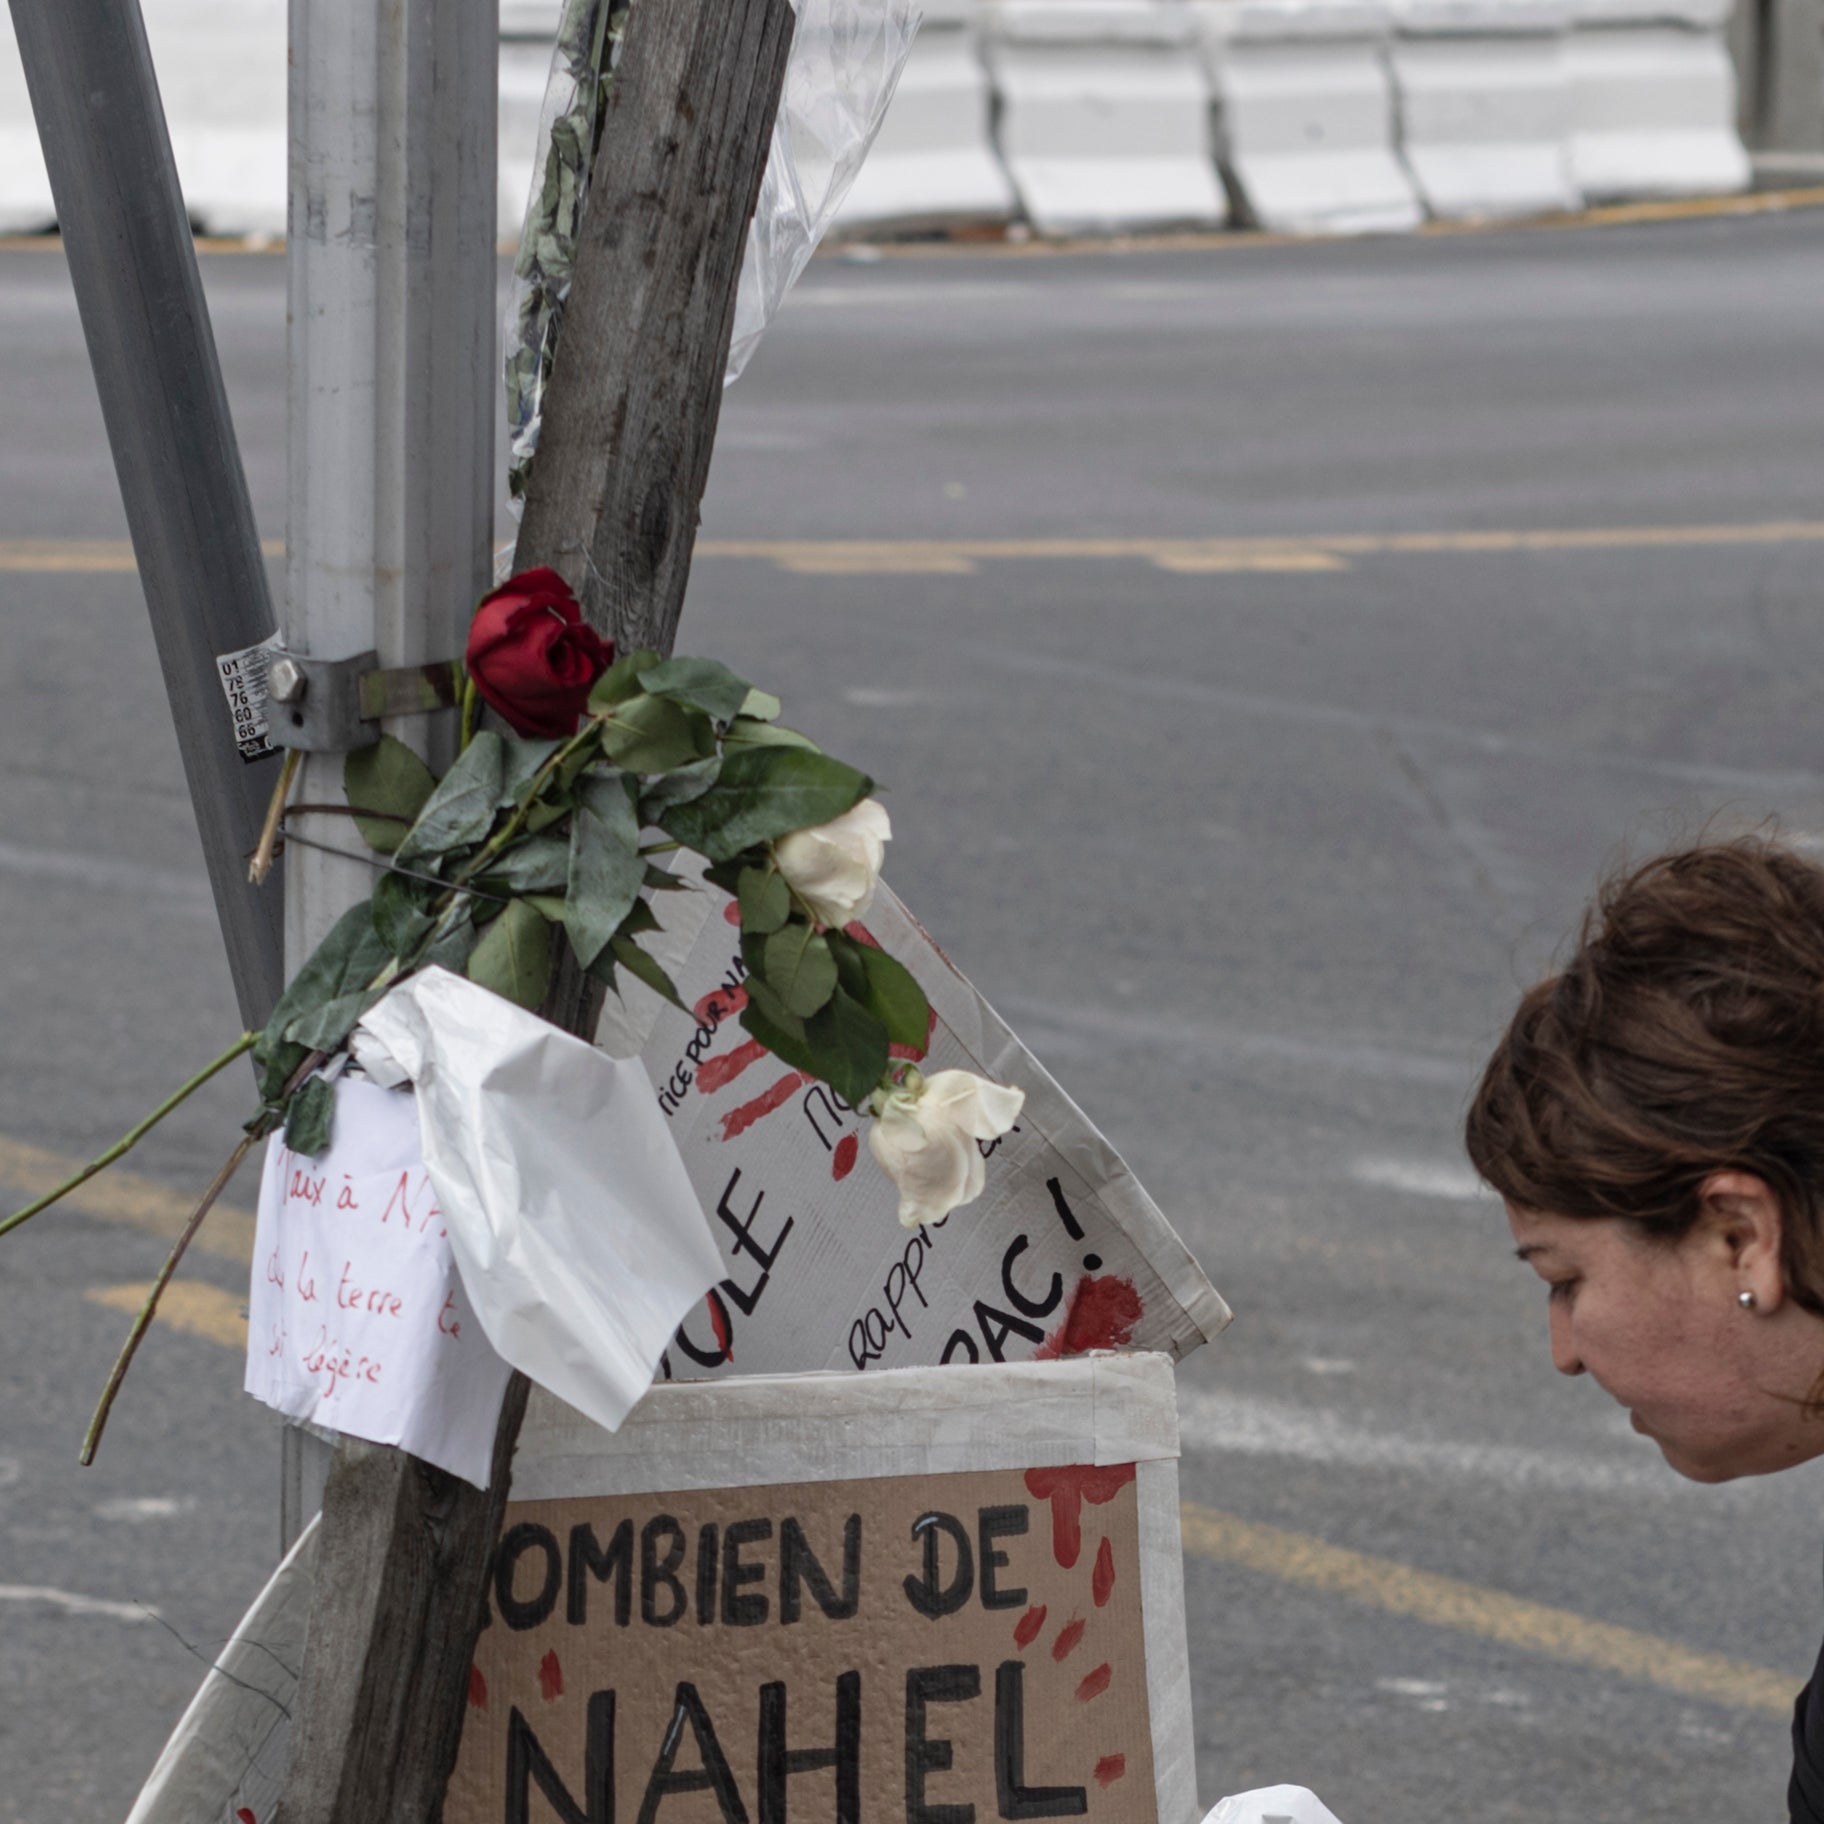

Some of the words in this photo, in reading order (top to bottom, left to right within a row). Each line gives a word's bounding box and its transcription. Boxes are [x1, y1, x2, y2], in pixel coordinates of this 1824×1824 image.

[222, 660, 239, 675] 01
[230, 691, 248, 707] 76
[235, 707, 252, 722] 60
[238, 723, 256, 738] 66
[686, 1001, 728, 1065] POUR
[722, 955, 750, 999] NA
[337, 1174, 359, 1210] à
[296, 1251, 317, 1301] la
[336, 1261, 403, 1318] terre
[438, 1290, 462, 1341] te
[303, 1325, 382, 1399] légère
[480, 1512, 861, 1632] OMBIEN
[903, 1504, 1030, 1621] DE
